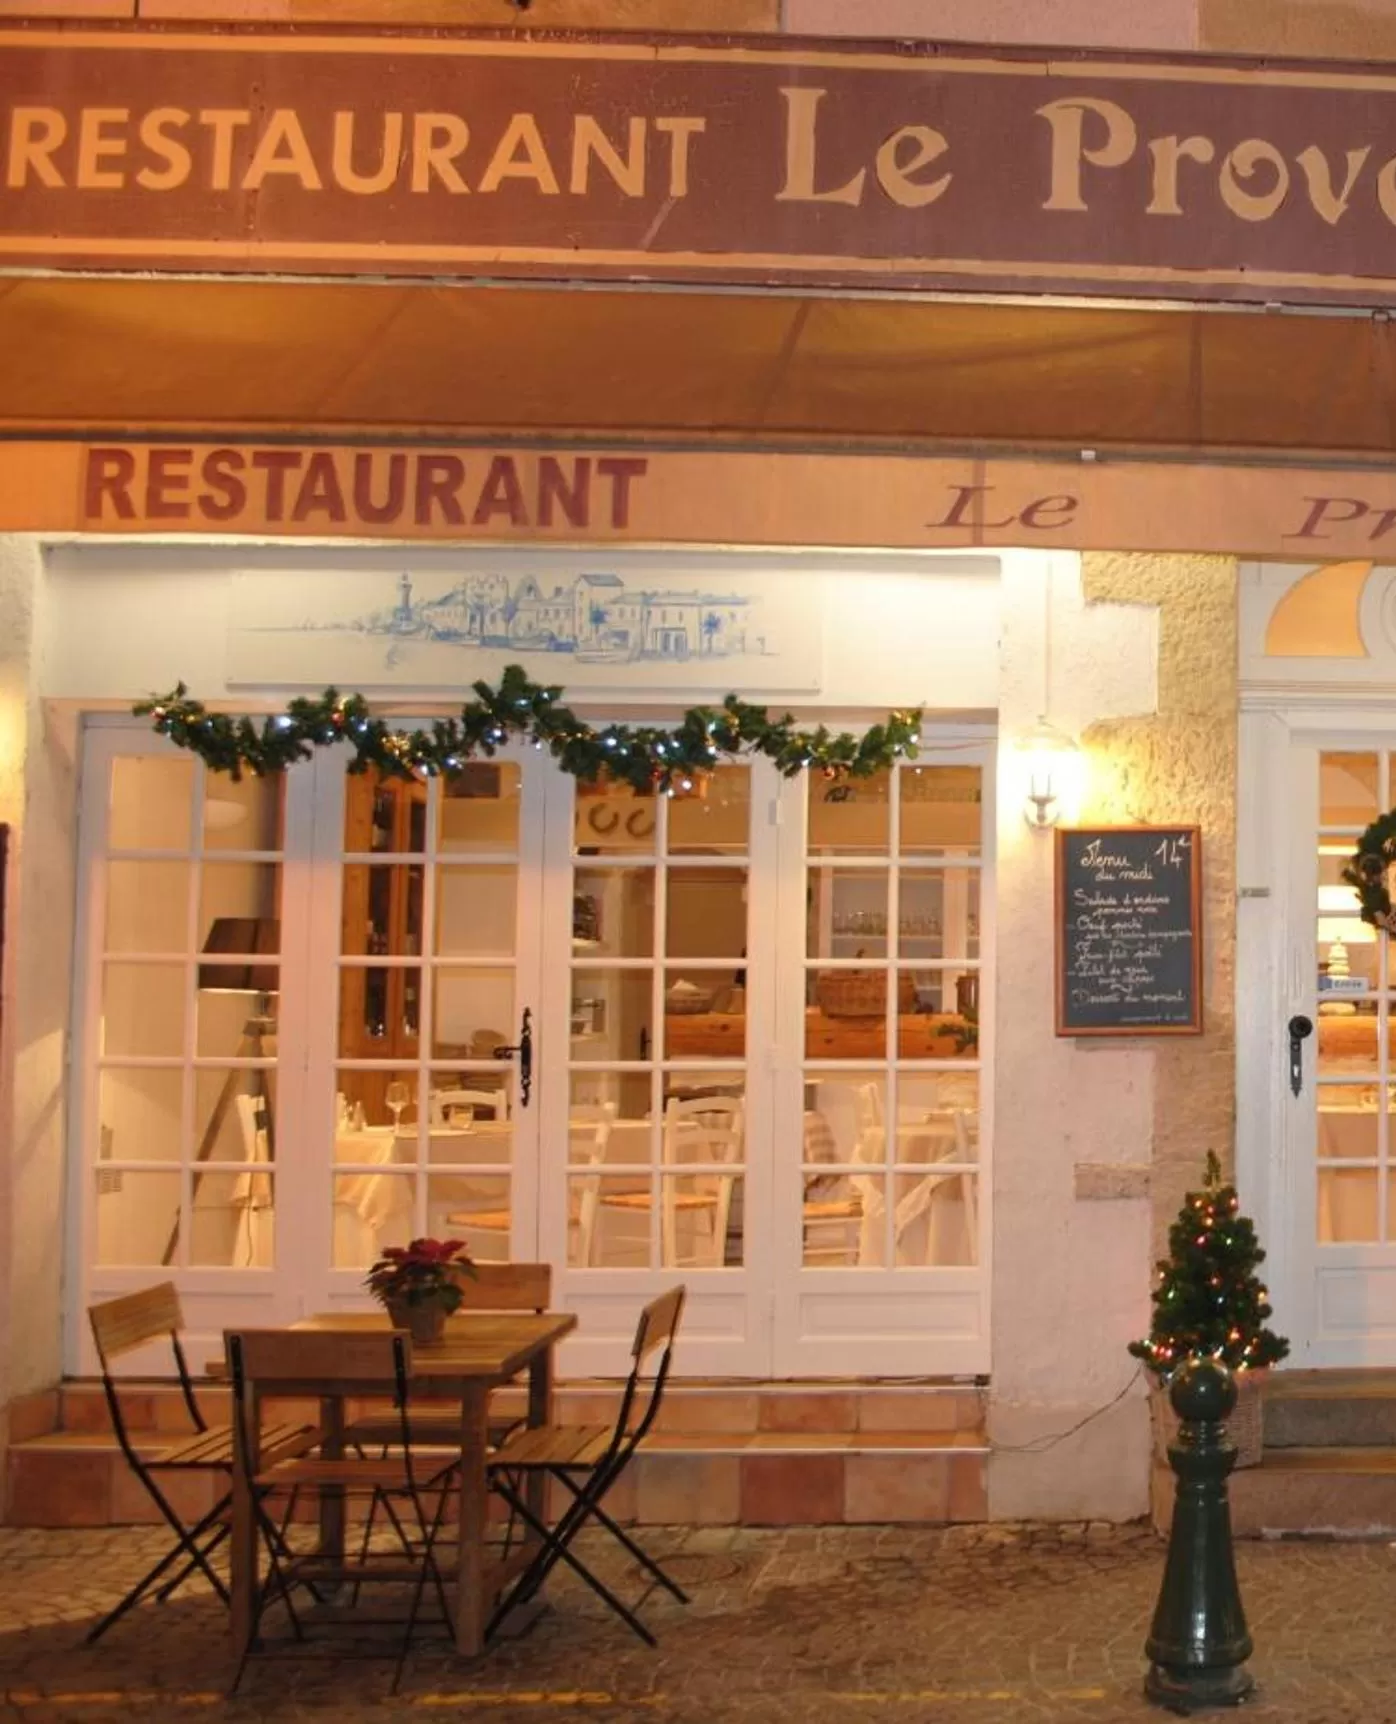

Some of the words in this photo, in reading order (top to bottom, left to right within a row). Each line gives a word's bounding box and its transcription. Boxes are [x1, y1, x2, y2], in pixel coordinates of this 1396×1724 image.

[6, 106, 706, 198] RESTAURANT
[775, 86, 953, 208] Le
[84, 447, 647, 530] RESTAURANT
[924, 484, 1080, 530] Le
